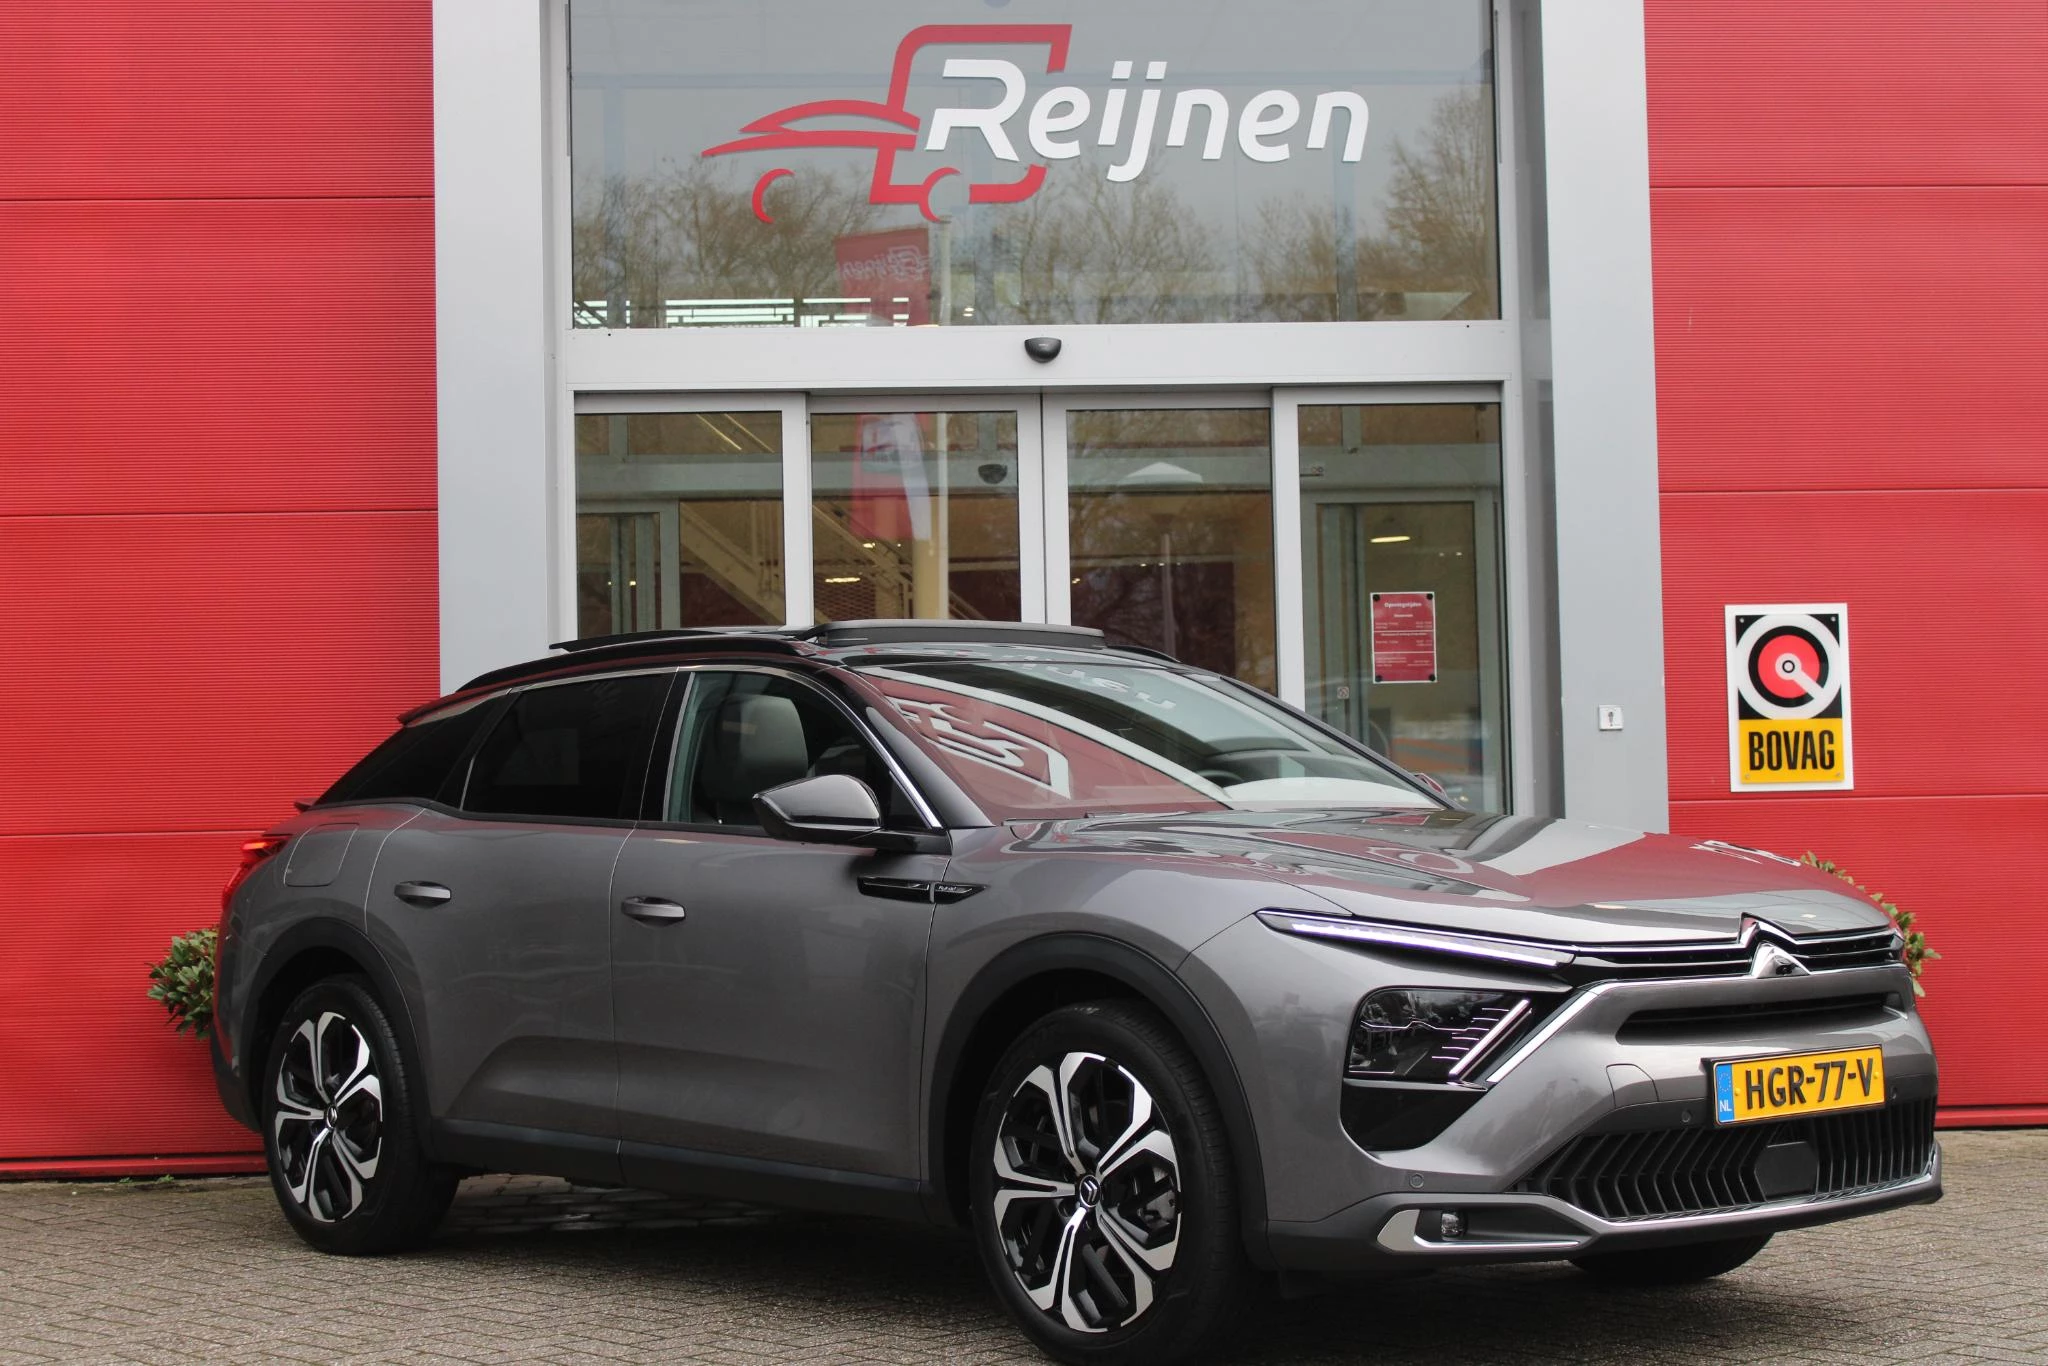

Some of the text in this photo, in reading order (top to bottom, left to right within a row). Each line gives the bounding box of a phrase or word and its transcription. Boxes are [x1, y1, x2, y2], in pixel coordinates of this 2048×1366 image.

[925, 58, 1370, 182] Reijnen
[1748, 730, 1835, 771] BOVAG
[1719, 1100, 1732, 1112] NL
[1745, 1058, 1874, 1110] HGR-77-V
